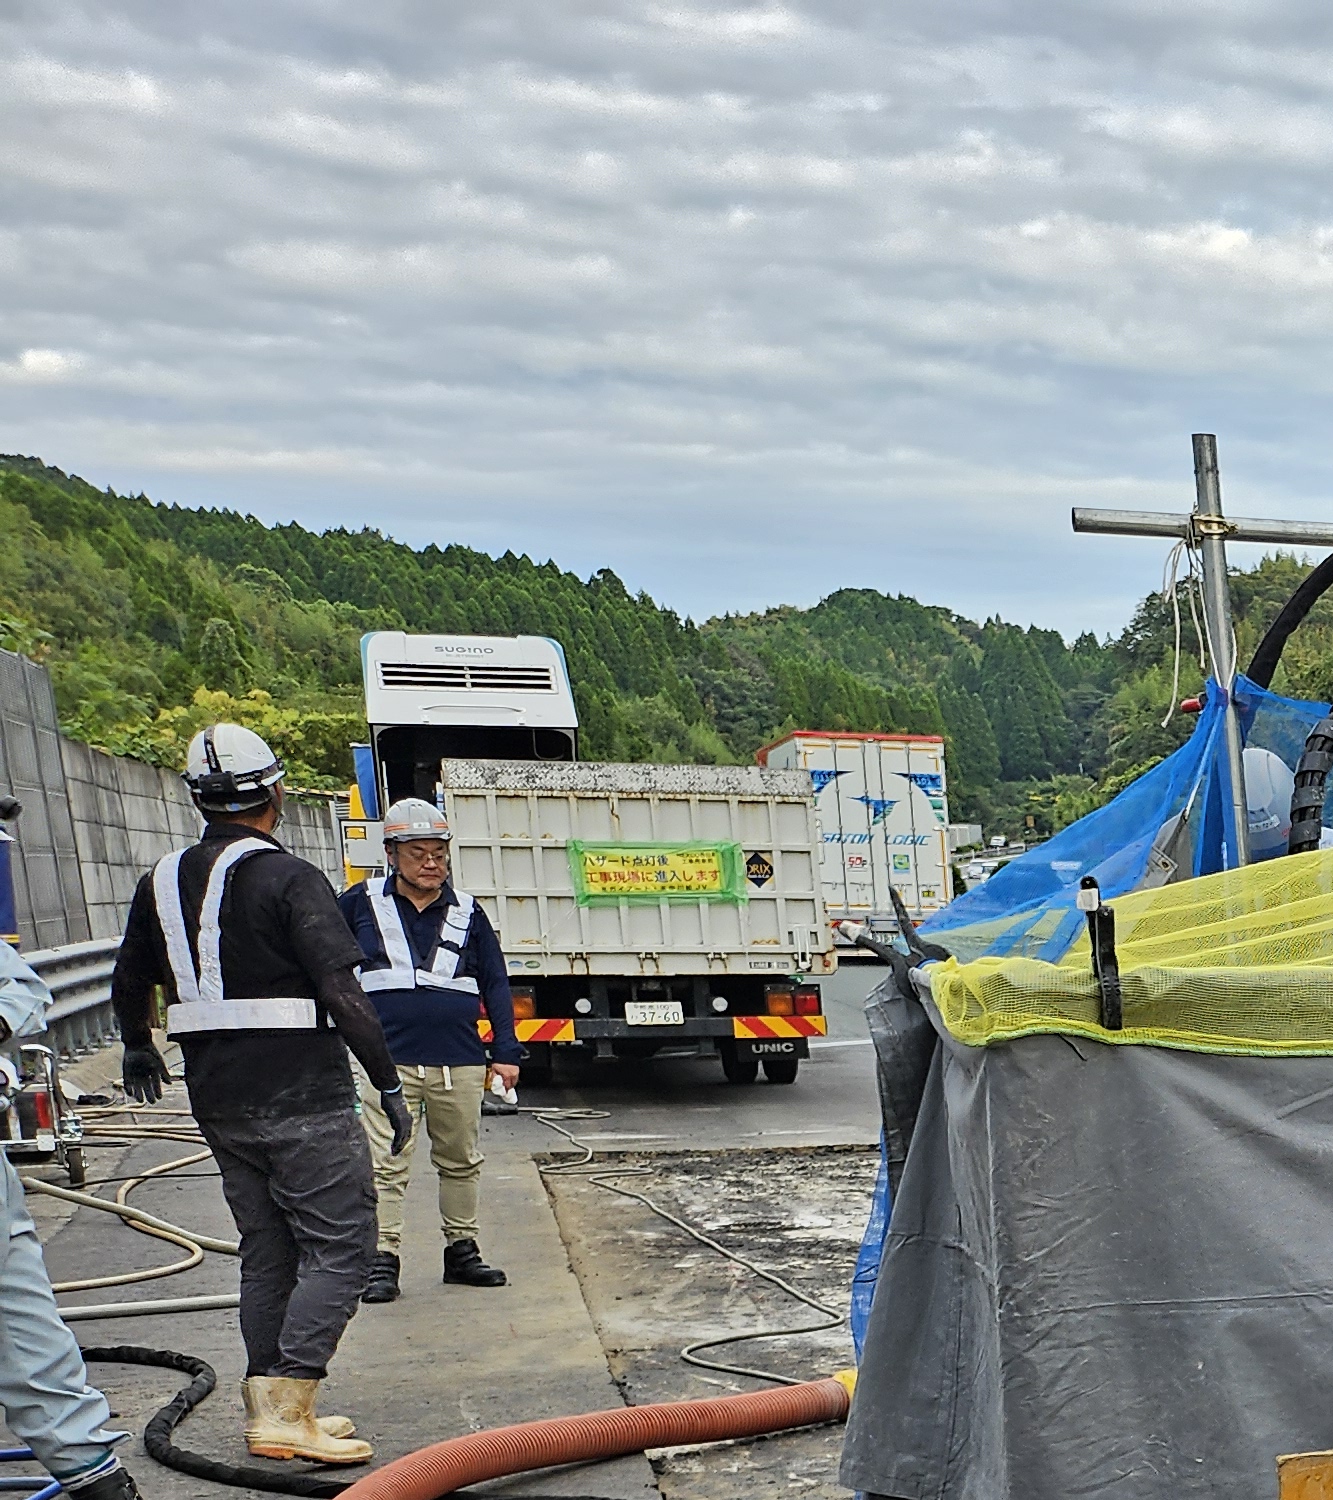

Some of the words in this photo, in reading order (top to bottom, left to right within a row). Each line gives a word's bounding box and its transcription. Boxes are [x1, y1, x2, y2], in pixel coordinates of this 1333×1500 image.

[584, 855, 669, 867] ハザード点灯後
[587, 870, 720, 883] 工事現場に進入します
[640, 1012, 680, 1022] 37-60
[751, 1042, 795, 1054] UNIC
